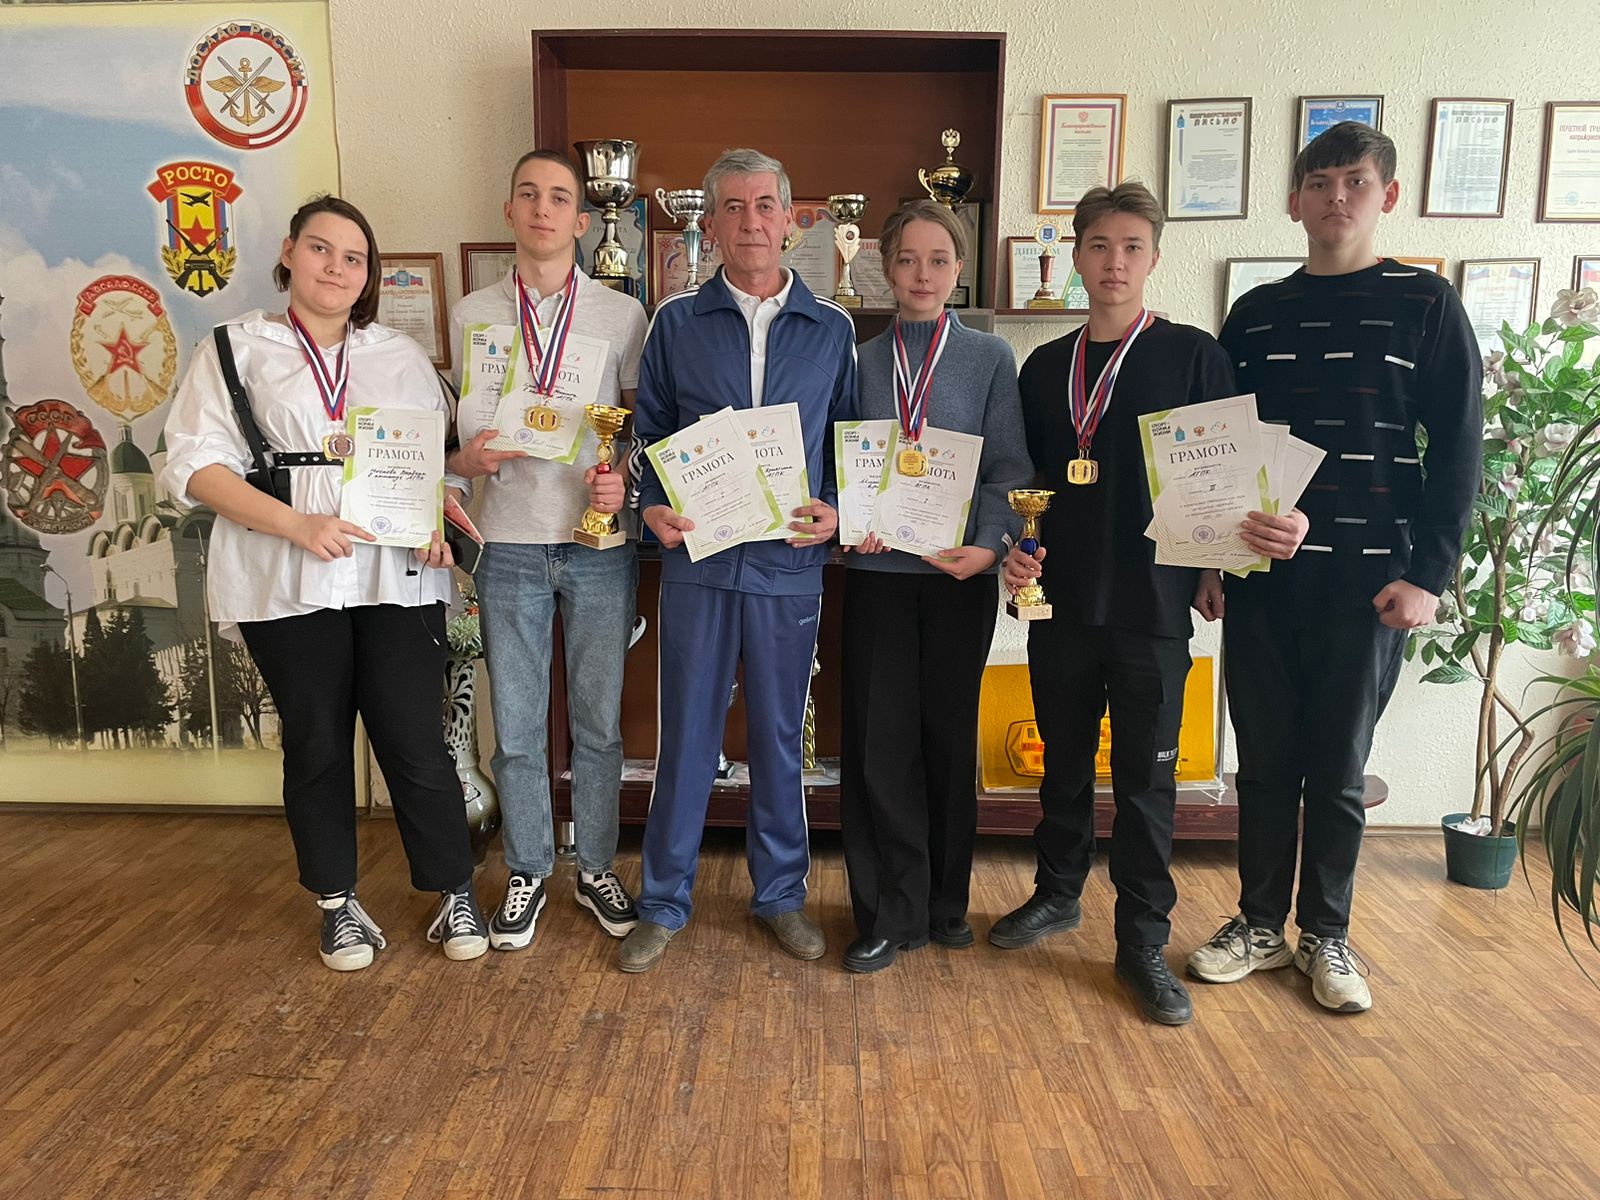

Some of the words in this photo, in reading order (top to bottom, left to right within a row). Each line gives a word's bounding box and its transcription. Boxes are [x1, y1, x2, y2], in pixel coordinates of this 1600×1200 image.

[187, 23, 241, 79] ДОСААФ
[249, 23, 305, 80] РОССИИ
[162, 166, 228, 187] РОСТО
[1014, 248, 1060, 256] ДИПЛМ
[132, 283, 156, 300] СССР
[368, 448, 425, 460] ГРАМОТА
[1169, 443, 1238, 464] ГРАМОТА
[682, 452, 735, 484] ГРАМОТА
